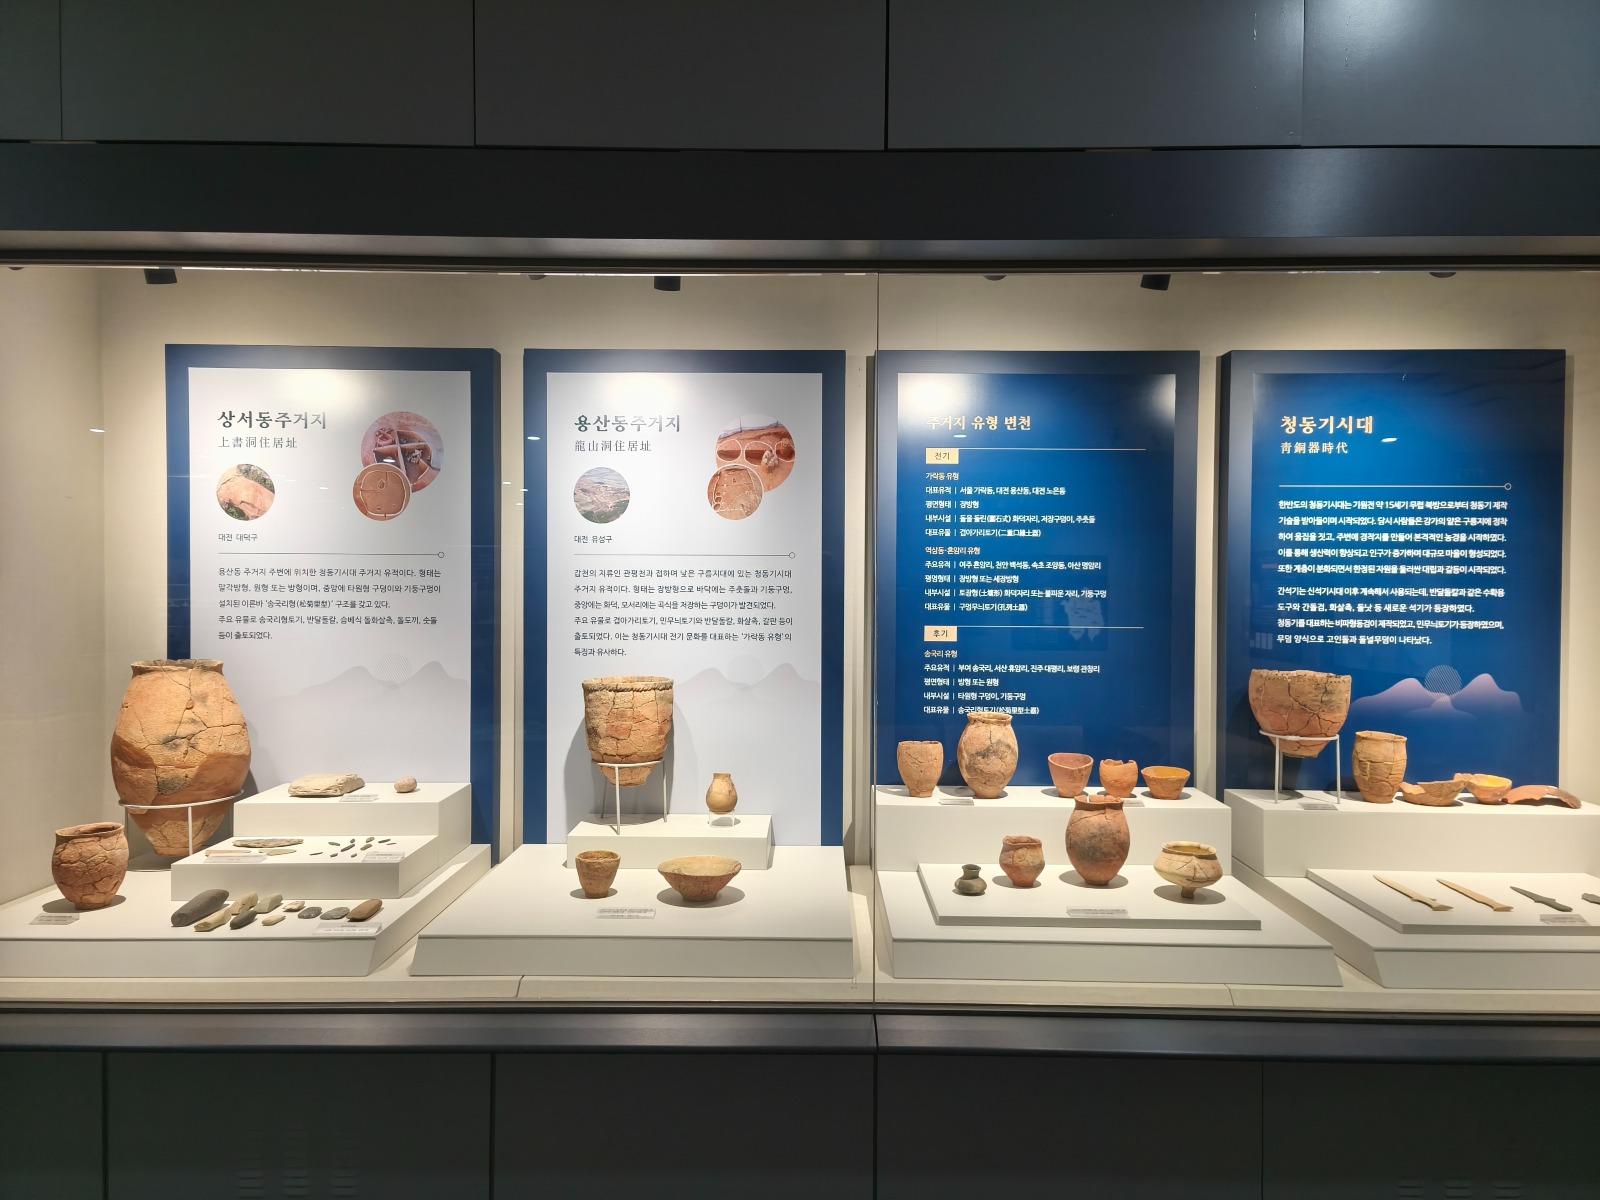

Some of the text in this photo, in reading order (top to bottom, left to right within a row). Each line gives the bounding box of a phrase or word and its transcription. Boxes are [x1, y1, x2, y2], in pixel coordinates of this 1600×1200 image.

[217, 411, 328, 429] 상서동주거지
[574, 415, 679, 432] 용산동주거지
[927, 416, 1030, 431] 주거지 유형 변천
[1281, 416, 1372, 434] 청동기시대
[218, 437, 297, 448] 上書洞住居址
[575, 440, 651, 451] 龍山洞住居址
[935, 452, 949, 460] 전기
[960, 486, 973, 494] 서울
[996, 487, 1009, 495] 대전
[1032, 487, 1045, 495] 대전
[1279, 500, 1307, 509] 한반도의
[1470, 501, 1491, 510] 청동기
[1377, 517, 1392, 525] 당시
[218, 534, 258, 542] 대전 대덕구
[574, 536, 612, 544] 대전 유성구
[1278, 532, 1293, 541] 하여
[1336, 533, 1359, 541] 주변에
[1369, 549, 1391, 557] 인구가
[1422, 549, 1445, 558] 대규모
[925, 561, 950, 569] 주요유적
[1068, 562, 1081, 570] 아산
[1277, 564, 1293, 573] 또한
[219, 568, 441, 577] 용산동 주거지 주변에 위치한 청동기시대 주거지 유적이다. 형태는
[574, 570, 791, 578] 갑천의 지류인 관평천과 접하며 낮은 구릉지대에 있는 청동기시대
[979, 575, 992, 583] 또는
[254, 584, 440, 593] 원형 또는 방형이며, 중앙에 타원형 구덩이와 기둥구멍이
[574, 585, 792, 594] 주거지 유적이다. 형태는 장방형으로 바닥에는 주춧돌과 기둥구멍,
[1307, 587, 1343, 595] 신석기시대
[1030, 590, 1044, 598] 또는
[219, 600, 390, 609] 설치된 이른바 구조를 갖고 있다.
[574, 601, 776, 610] 중앙에는 화덕, 모서리에는 곡식을 저장하는 구덩이가 발견되었다.
[1277, 603, 1300, 611] 도구와
[1374, 604, 1382, 612] 등
[1383, 604, 1407, 612] 새로운
[1409, 604, 1432, 612] 석기가
[218, 616, 438, 625] 주요 유물로 송국리형토기, 반달돌칼, 돌도끼, 숫돌
[574, 617, 792, 626] 주요 유물로 민무늬토기와 반달돌칼, 화살촉, 갈판 등이
[218, 632, 272, 640] 등이 출토되었다.
[574, 632, 739, 641] 출토되었다. 이는 청동기시대 전기 문화를 대표하는
[933, 630, 947, 638] 후기
[1277, 635, 1292, 643] 무덤
[1294, 635, 1324, 643] 양식으로
[574, 648, 626, 656] 특징과 유사하다.
[924, 664, 949, 672] 주요유적
[1030, 665, 1044, 673] 진주
[972, 678, 985, 686] 또는
